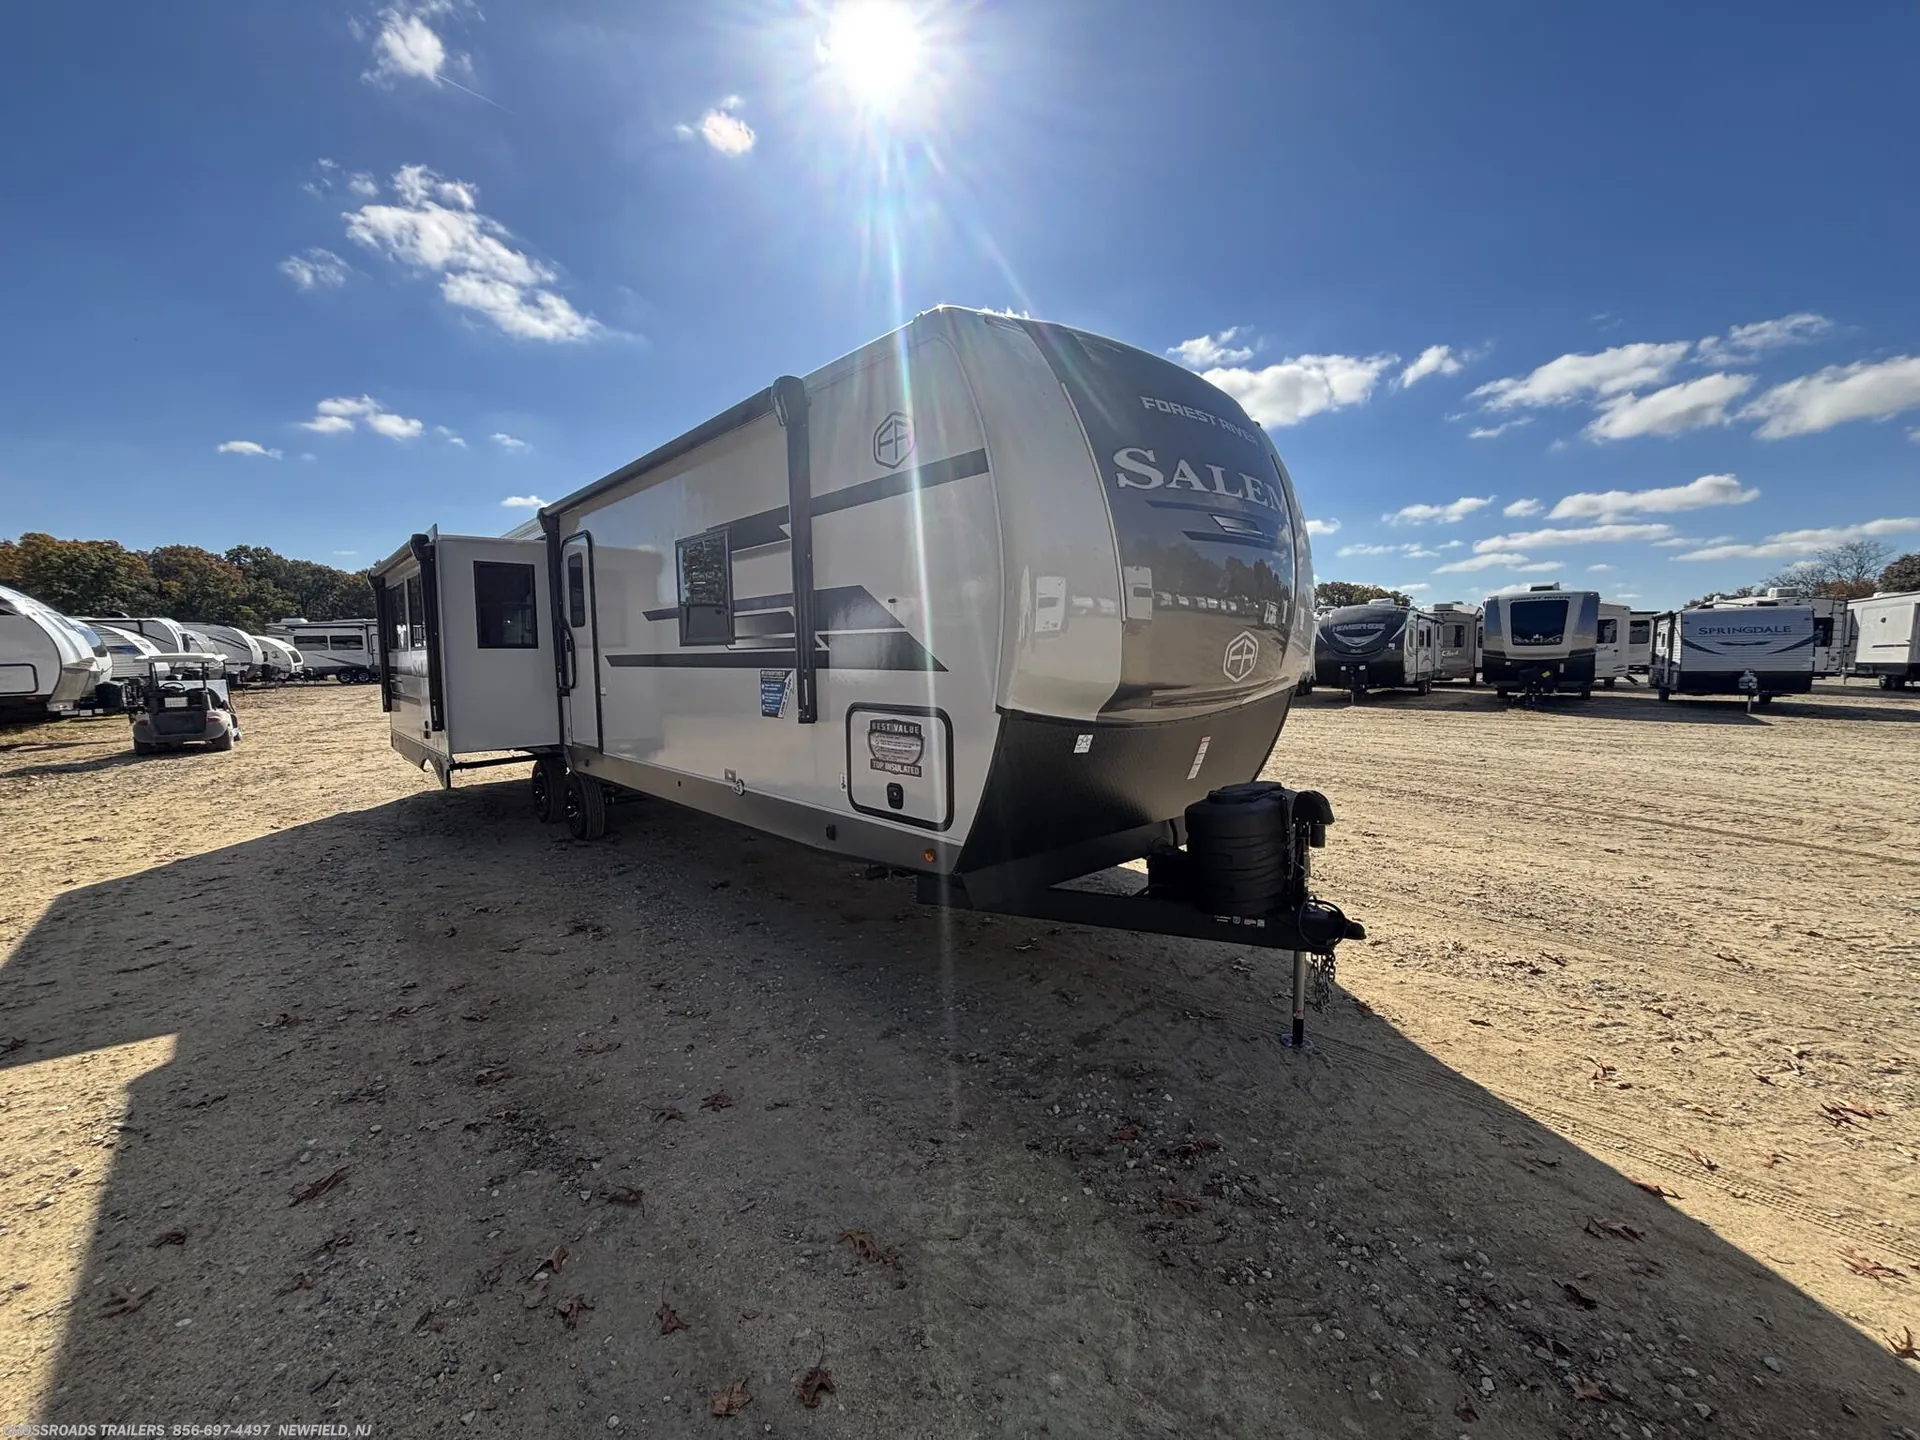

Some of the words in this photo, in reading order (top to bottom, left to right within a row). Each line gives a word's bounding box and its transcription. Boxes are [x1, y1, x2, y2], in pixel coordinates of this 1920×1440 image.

[1140, 396, 1216, 427] FOREST
[1221, 419, 1259, 446] RIVER
[1699, 625, 1792, 635] SPRINGDALE
[871, 721, 891, 732] BEST
[893, 723, 920, 735] VALUE
